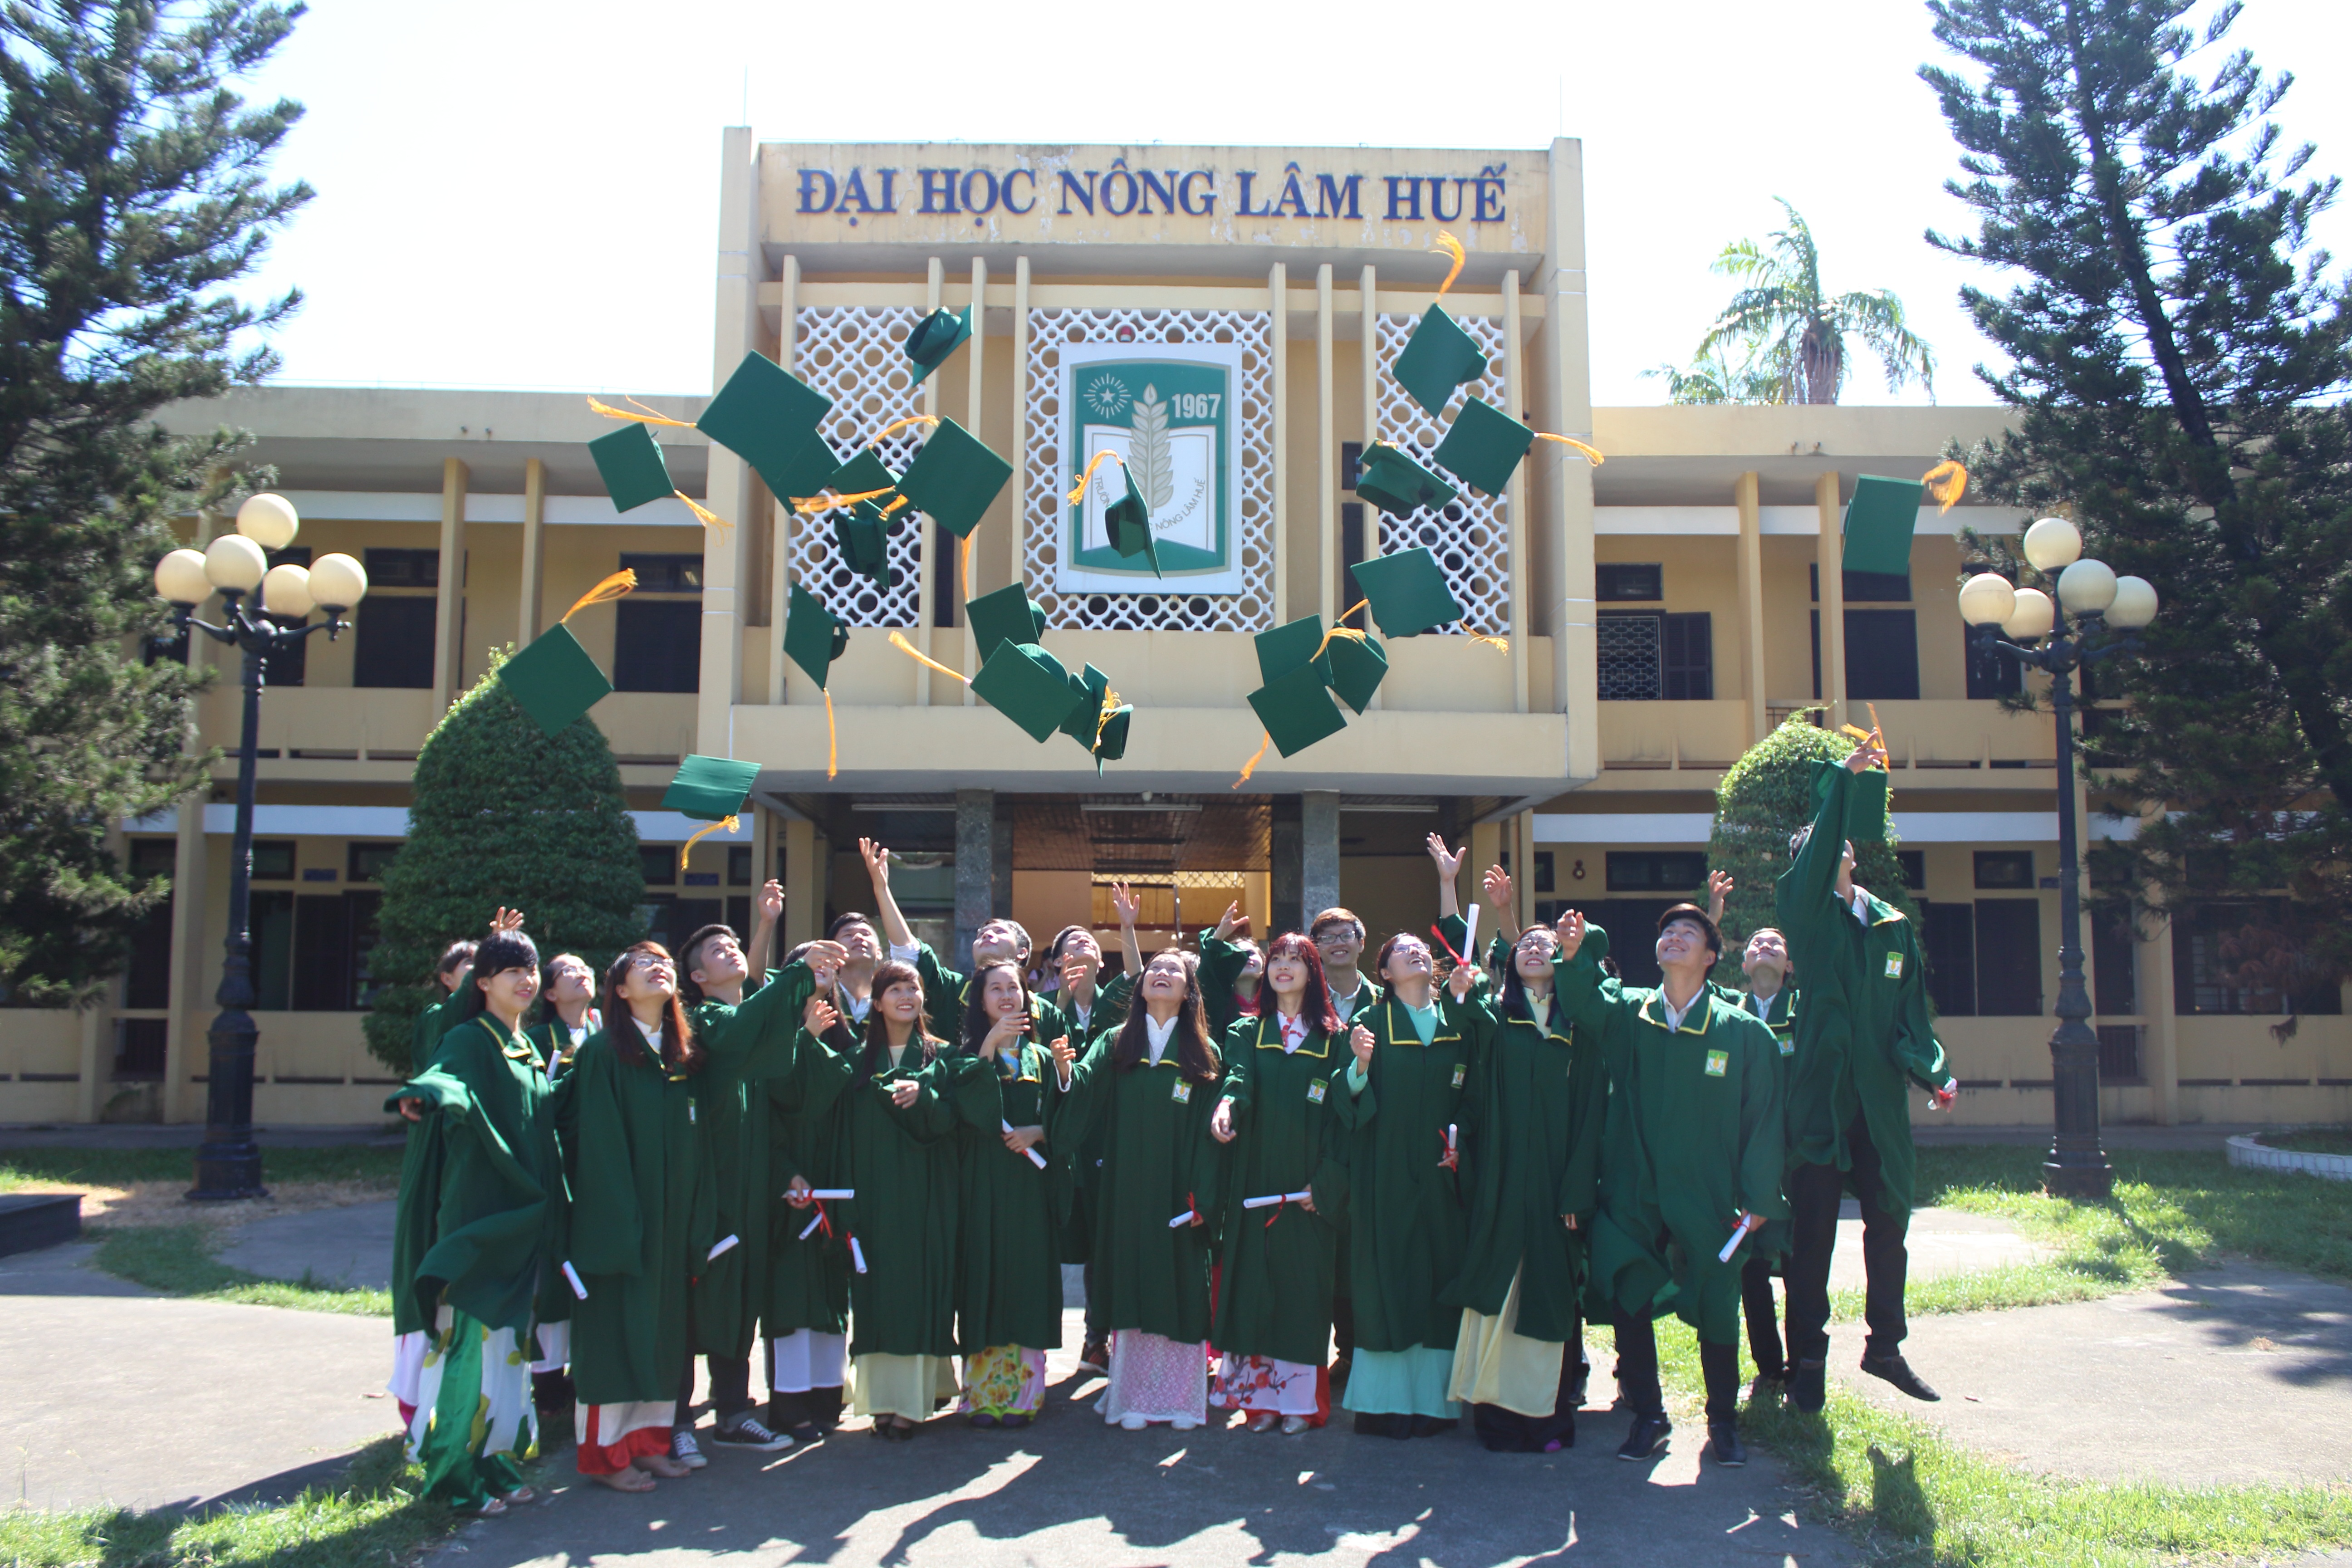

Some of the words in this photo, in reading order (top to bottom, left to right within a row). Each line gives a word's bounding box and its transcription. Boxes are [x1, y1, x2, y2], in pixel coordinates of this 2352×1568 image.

[796, 167, 897, 226] ĐẠI
[917, 168, 1037, 226] HỌC
[1057, 157, 1218, 216] NÔNG
[1235, 161, 1363, 220] LÂM
[1383, 162, 1507, 222] HUẾ
[1172, 393, 1221, 418] 1967
[1094, 475, 1113, 508] TRƯỜN
[1155, 513, 1183, 531] NÔNG
[1181, 498, 1199, 516] LÂM
[1193, 477, 1205, 498] HUẾ
